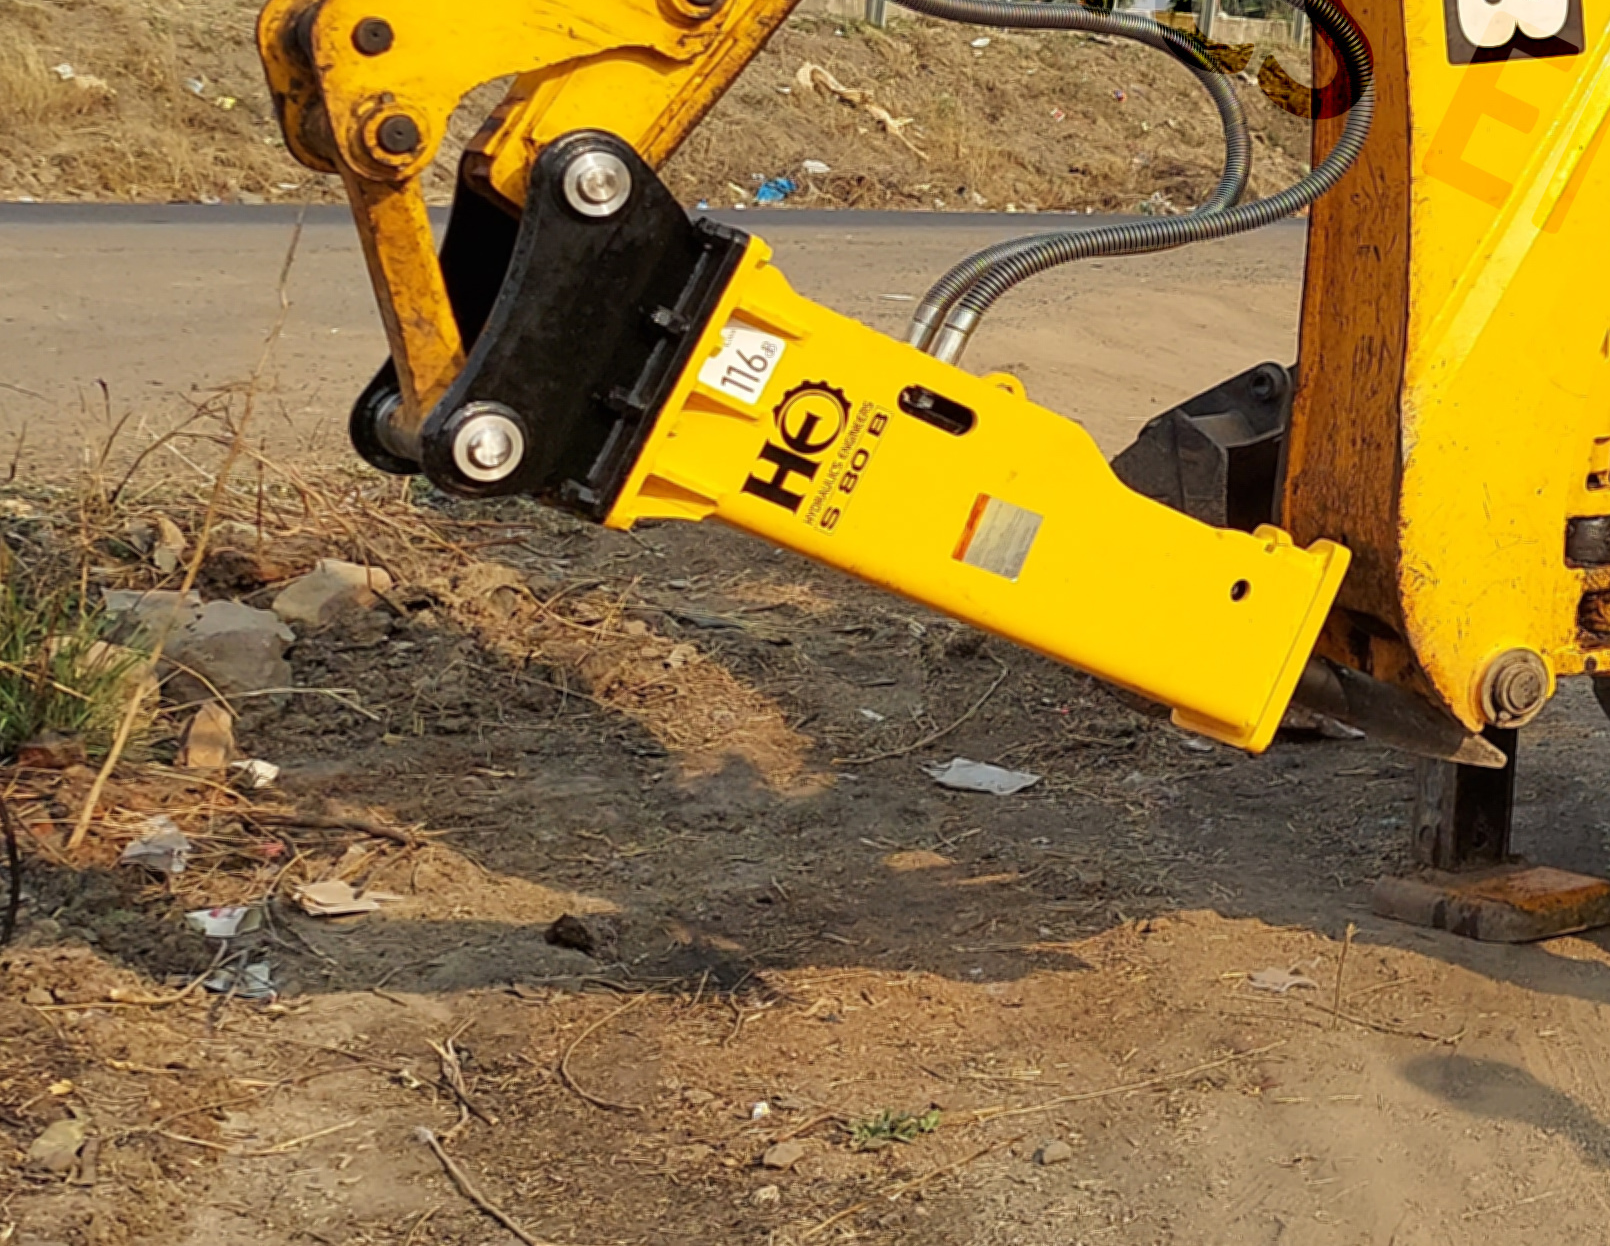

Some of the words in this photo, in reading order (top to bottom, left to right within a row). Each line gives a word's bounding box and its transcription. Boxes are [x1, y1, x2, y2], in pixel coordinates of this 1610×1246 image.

[720, 349, 768, 393] 116
[820, 506, 840, 529] S
[838, 448, 870, 494] 80
[867, 412, 888, 437] B
